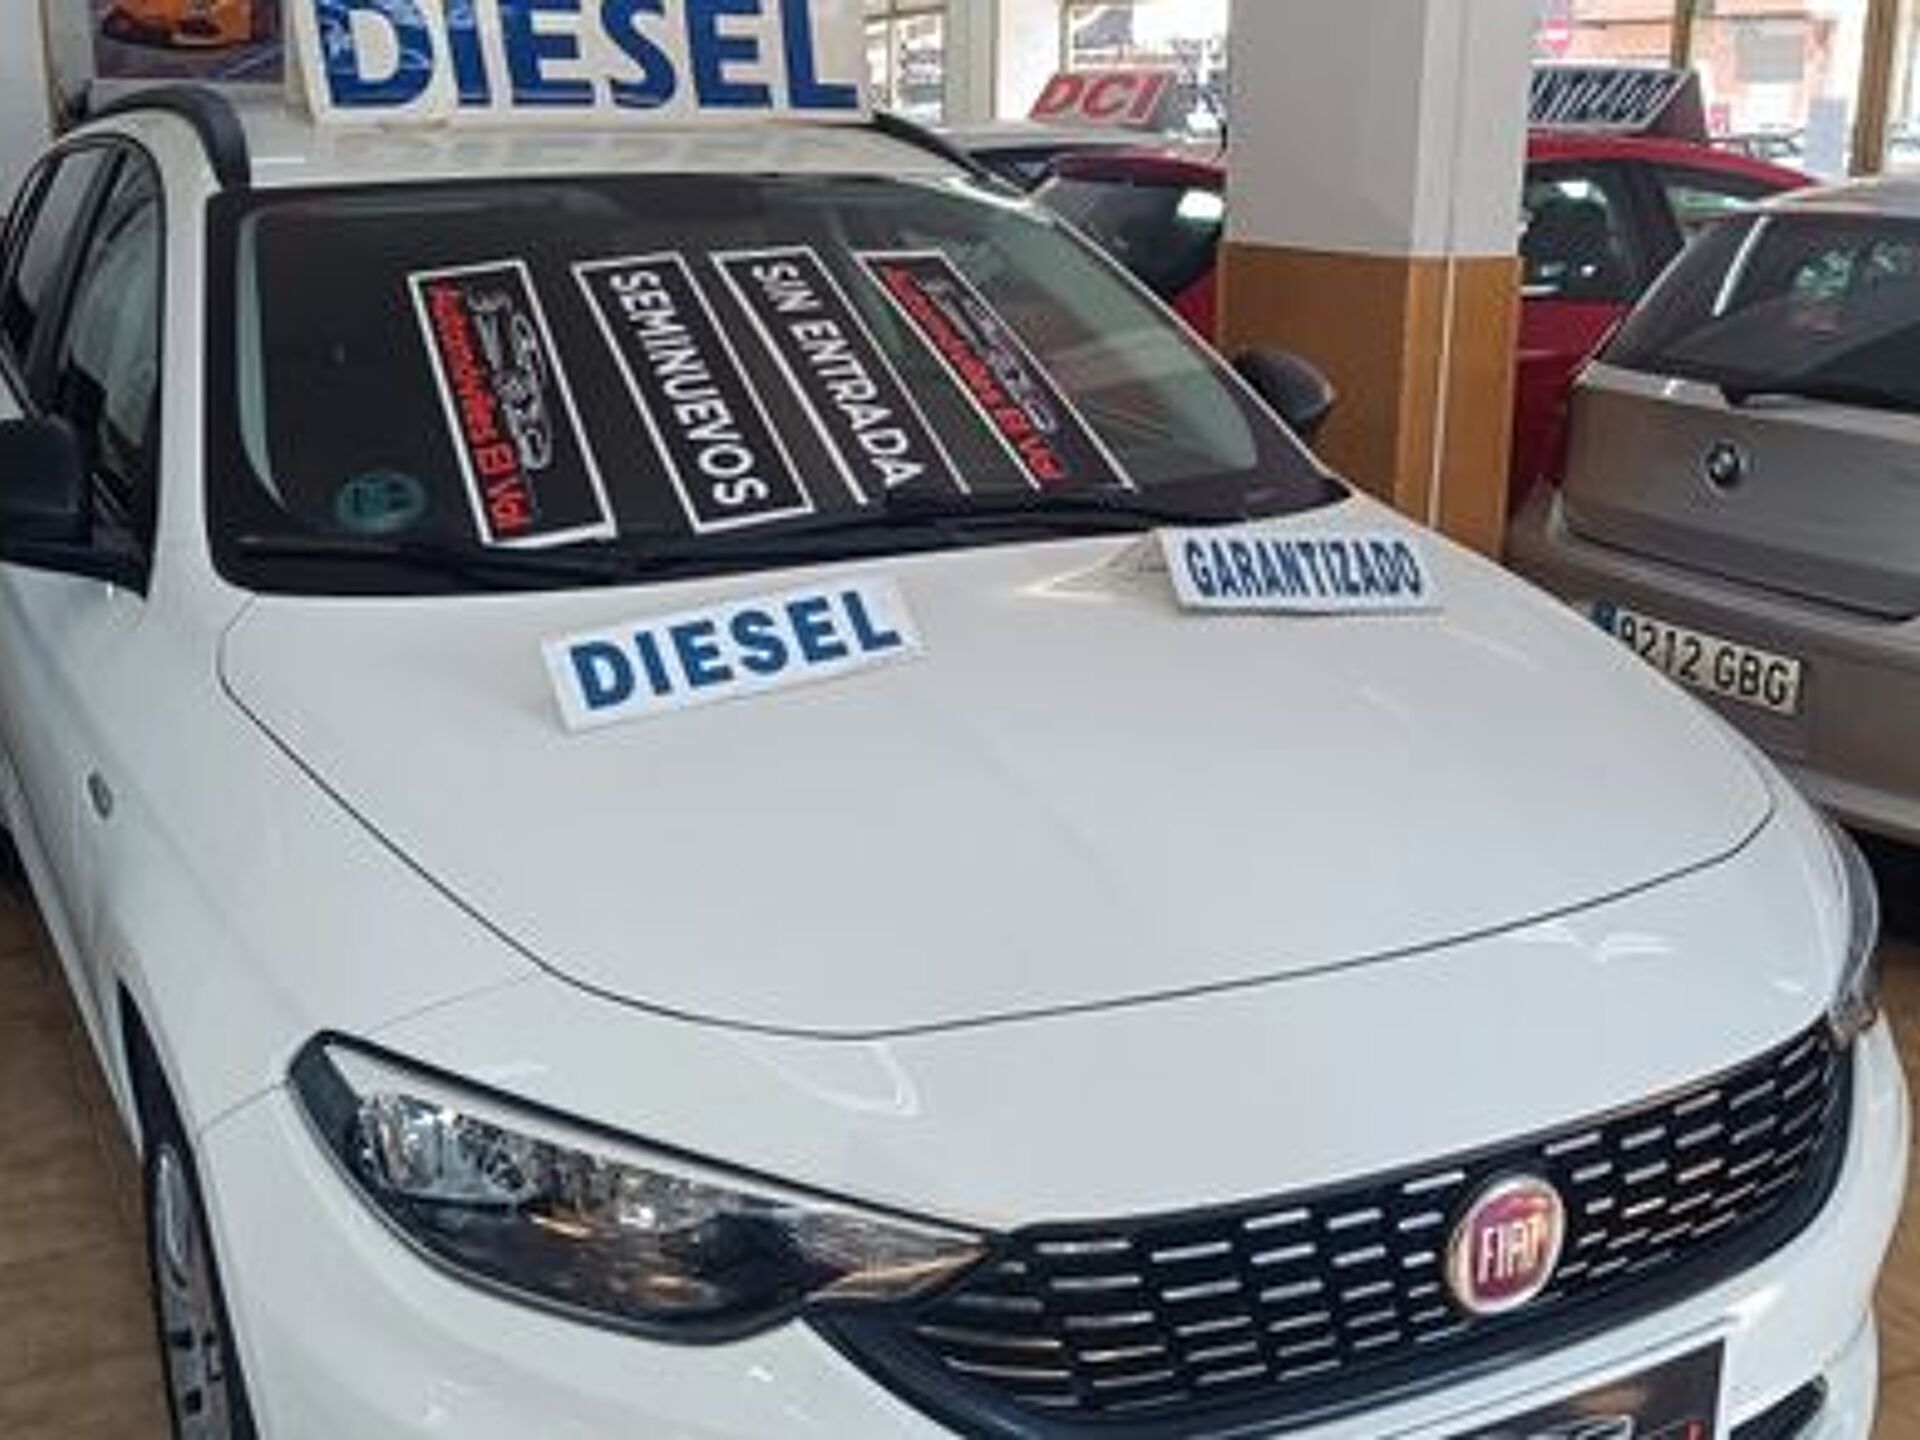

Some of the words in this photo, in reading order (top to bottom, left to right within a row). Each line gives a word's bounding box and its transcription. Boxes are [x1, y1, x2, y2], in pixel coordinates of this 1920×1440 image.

[315, 0, 858, 108] DIESEL
[1030, 74, 1166, 120] DCI
[609, 270, 769, 506] SEMINUEVOS
[752, 263, 821, 313] SIN
[788, 319, 925, 489] ENTRADA
[1185, 540, 1421, 596] GARANTIZADO
[570, 591, 900, 710] DIESEL
[1621, 616, 1702, 682] 9212
[1714, 648, 1789, 705] GBG
[1477, 1212, 1544, 1284] FIAT
